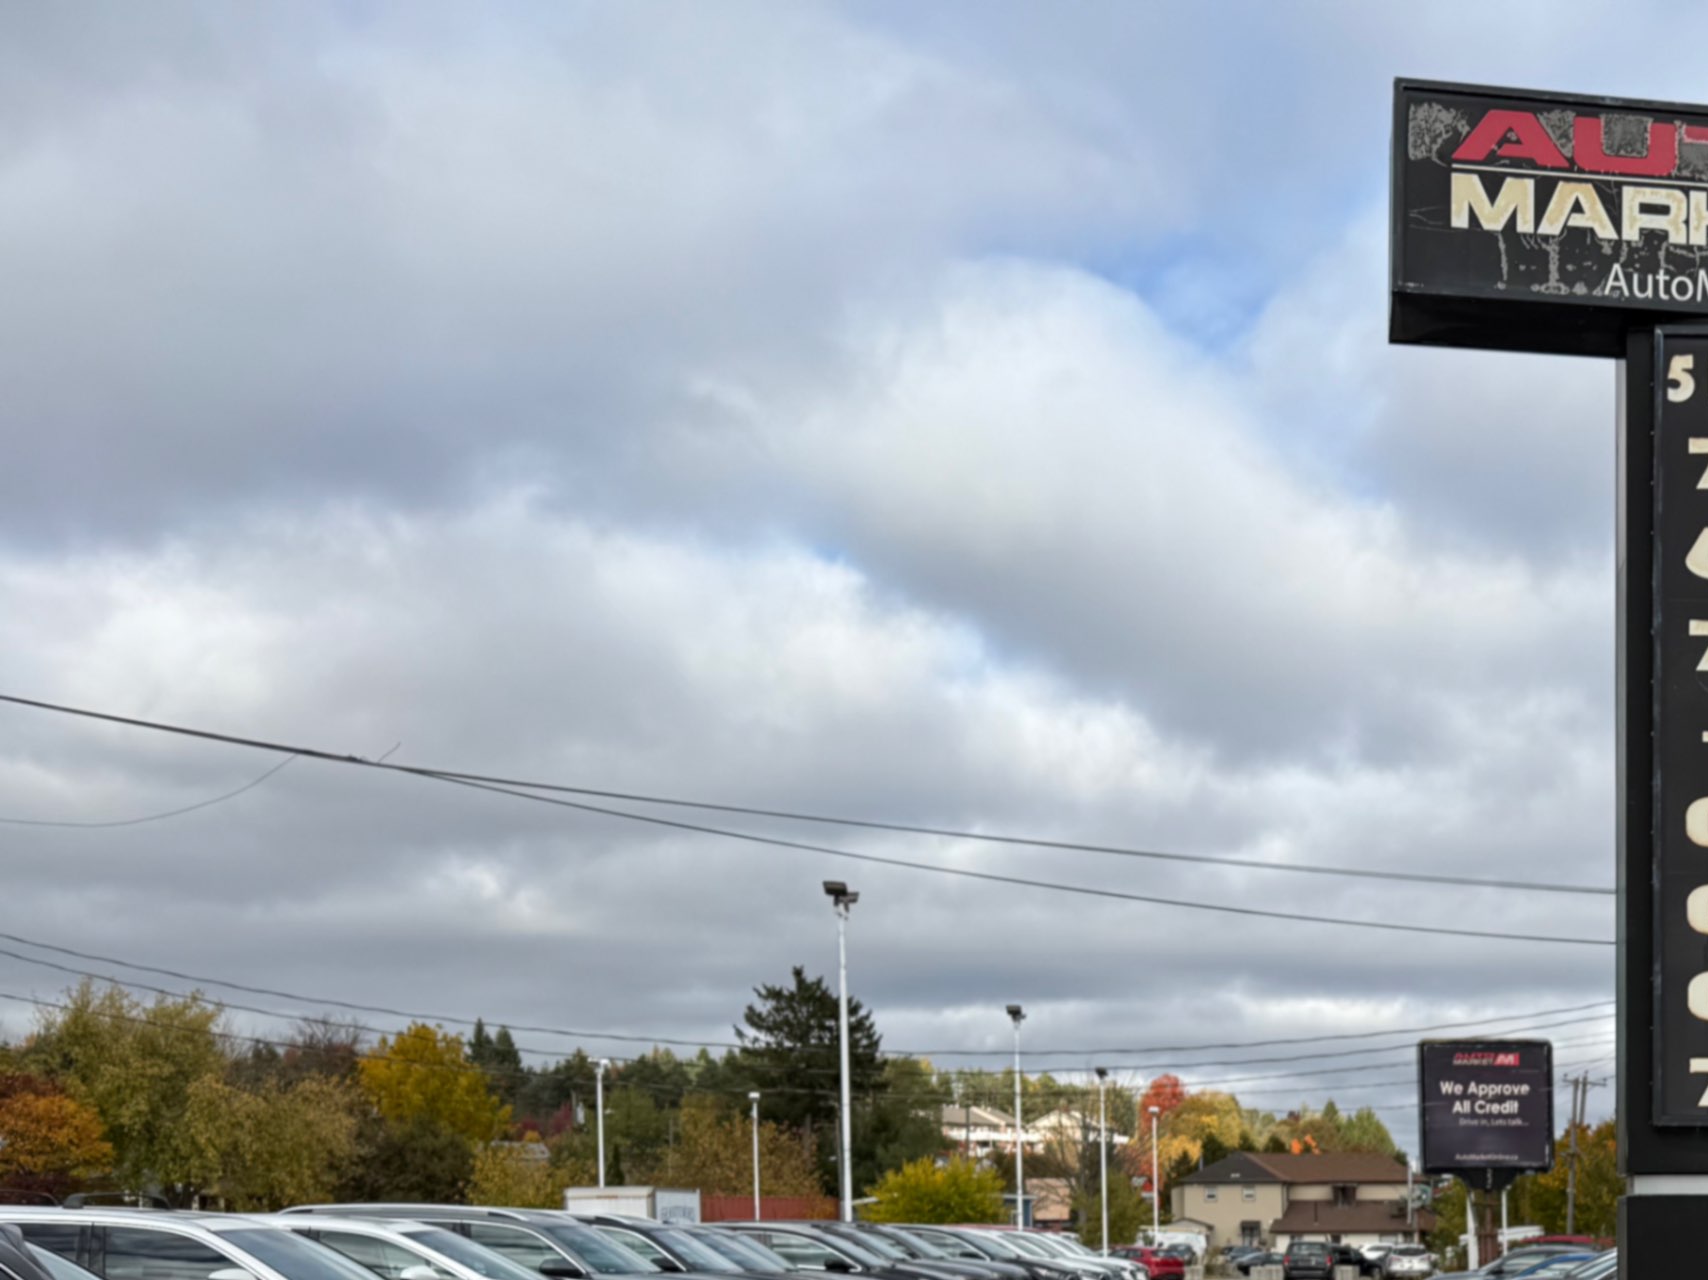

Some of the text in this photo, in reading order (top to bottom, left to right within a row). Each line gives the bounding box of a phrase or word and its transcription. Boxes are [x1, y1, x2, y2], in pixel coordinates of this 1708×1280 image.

[1439, 1081, 1531, 1098] We Approve
[1452, 1100, 1519, 1115] All Credit
